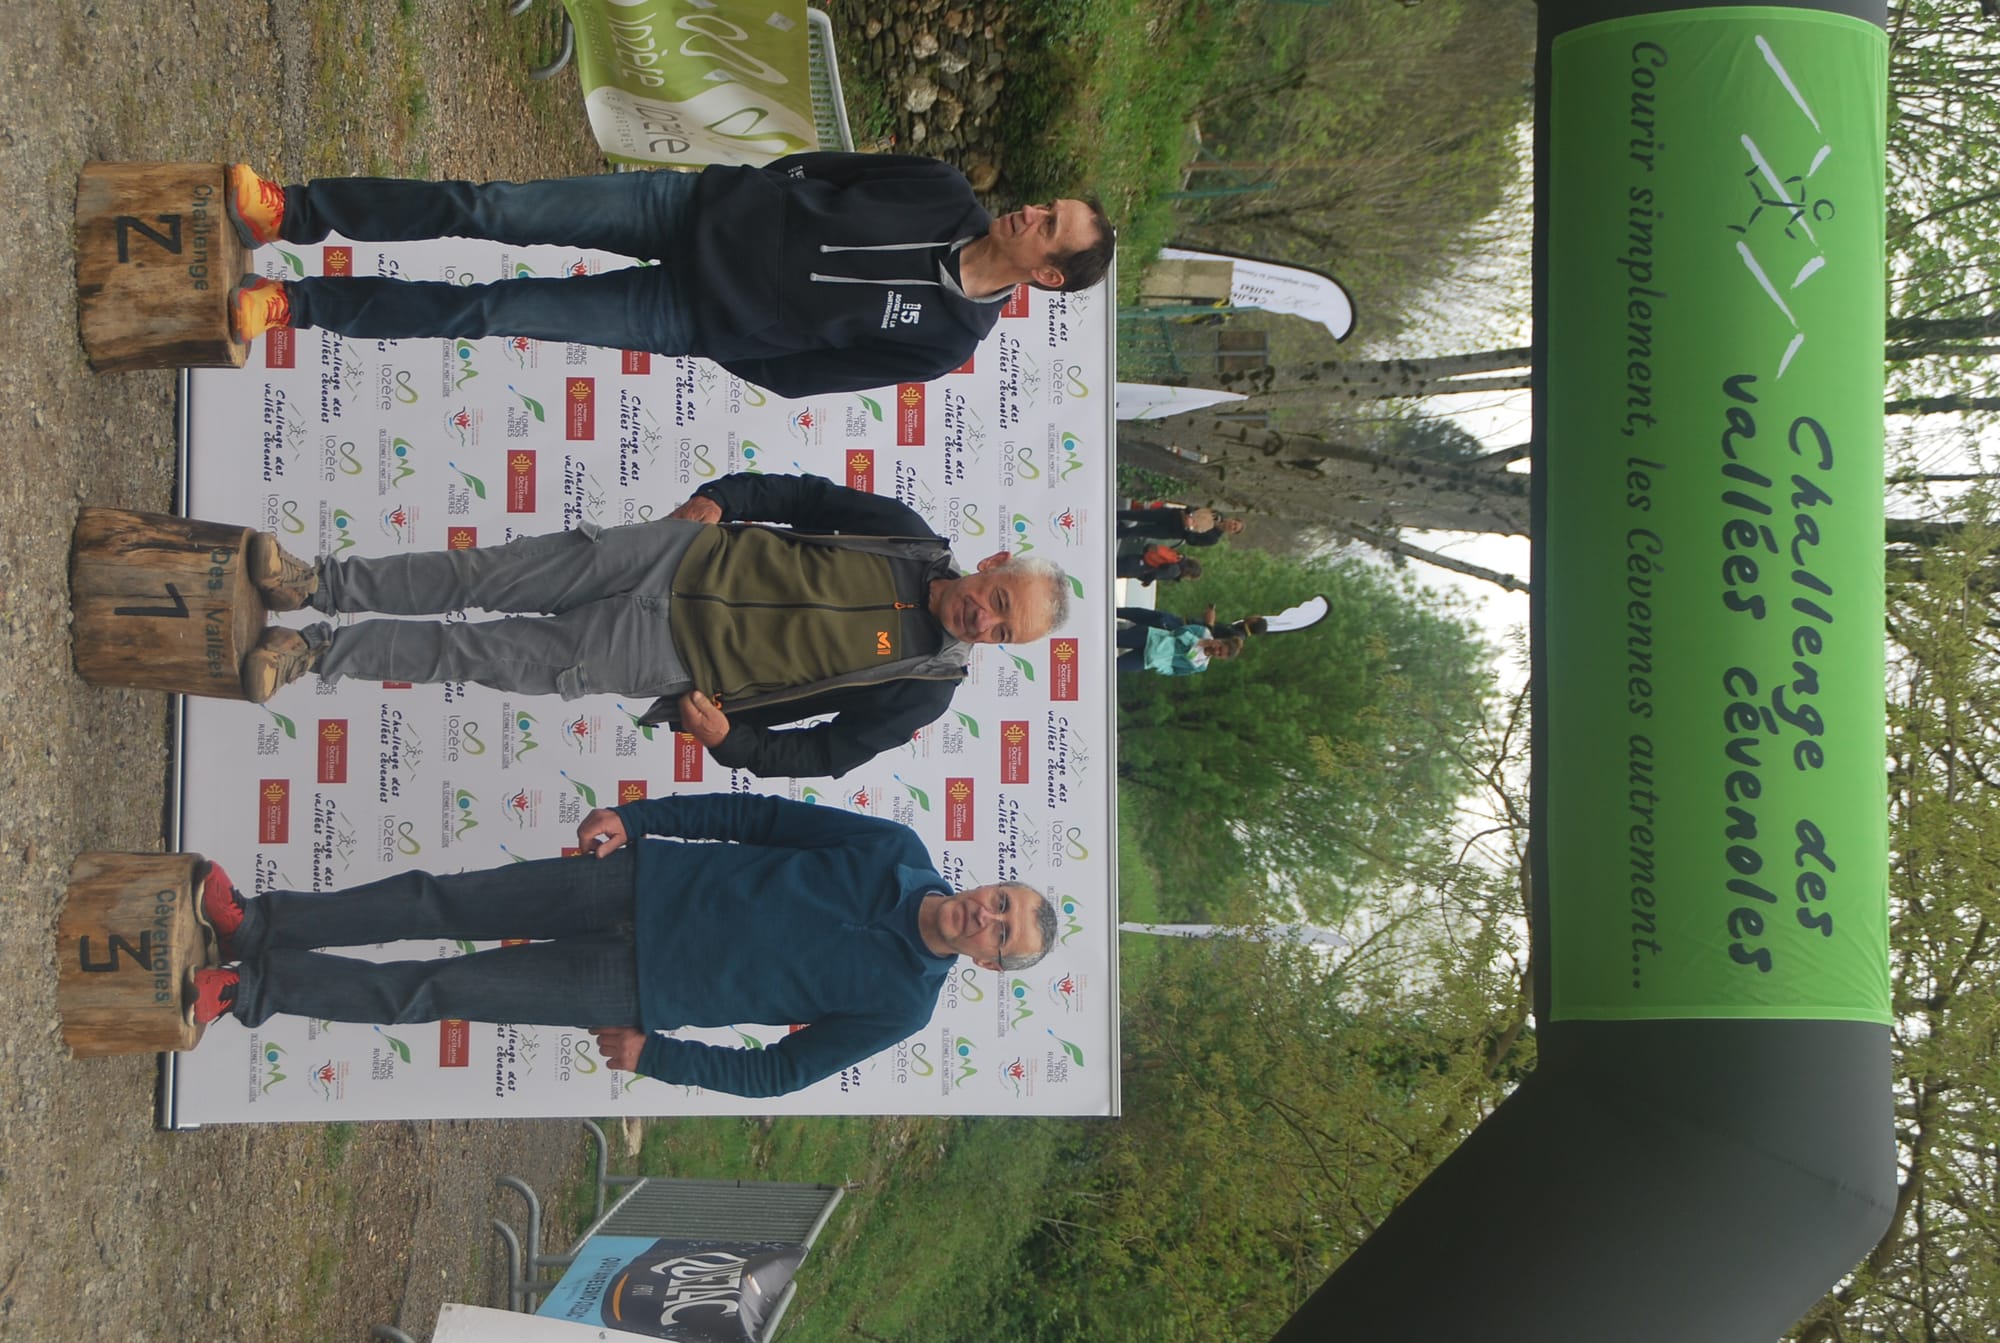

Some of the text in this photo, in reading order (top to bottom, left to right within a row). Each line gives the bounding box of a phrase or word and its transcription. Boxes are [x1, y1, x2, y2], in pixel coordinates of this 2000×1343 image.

[189, 184, 213, 291] Challenge
[321, 330, 333, 366] allées
[999, 332, 1010, 373] vallées
[1059, 322, 1068, 342] des
[381, 364, 395, 410] lozère
[729, 374, 744, 414] ozère
[1008, 339, 1020, 424] Challenge des
[1052, 359, 1066, 405] lozère
[263, 382, 275, 424] vallées
[333, 398, 343, 418] des
[576, 403, 584, 438] Occitanie
[620, 389, 631, 430] vallées
[686, 401, 696, 420] des
[944, 388, 955, 429] vallées
[273, 389, 285, 476] Challenge des
[629, 396, 641, 480] Challenge des
[907, 409, 916, 444] Occitanie
[953, 395, 965, 480] Challenge des
[325, 435, 339, 481] lozère
[564, 455, 575, 496] vallées
[679, 438, 693, 484] lozère
[1003, 441, 1017, 487] lozère
[517, 476, 526, 510] Occitanie
[573, 462, 585, 520] Challenge
[904, 467, 916, 507] Challe
[949, 497, 963, 543] lozère
[1616, 41, 1667, 991] Courir simplement, les Cévennes autrement...
[207, 550, 230, 591] Des
[114, 583, 190, 619] 1
[1060, 664, 1068, 698] Occitanie
[1721, 374, 1778, 974] vallées cévenoles
[1773, 416, 1837, 938] Challenge des
[380, 703, 391, 745] vallées
[448, 715, 462, 761] lozère
[1047, 711, 1058, 752] vallées
[328, 745, 336, 780] Occitanie
[389, 710, 401, 796] Challenge des
[684, 745, 692, 780] Occitanie
[1010, 747, 1018, 782] Occitanie
[1056, 718, 1068, 802] Challenge des
[270, 805, 278, 840] Occitanie
[313, 793, 325, 835] vallées
[955, 804, 964, 838] Occitanie
[323, 800, 335, 887] Challenge des
[383, 815, 397, 861] lozère
[998, 794, 1009, 880] vallées cévenol
[1007, 801, 1019, 880] Challenge de
[1052, 821, 1066, 867] lozère
[943, 850, 954, 881] vallé
[952, 857, 964, 892] Chall
[79, 930, 152, 972] 3
[153, 890, 176, 1004] Cévenoles
[450, 1028, 459, 1064] Occitanie
[560, 1034, 574, 1080] lozère
[896, 1042, 911, 1083] ozère
[508, 1071, 517, 1092] des
